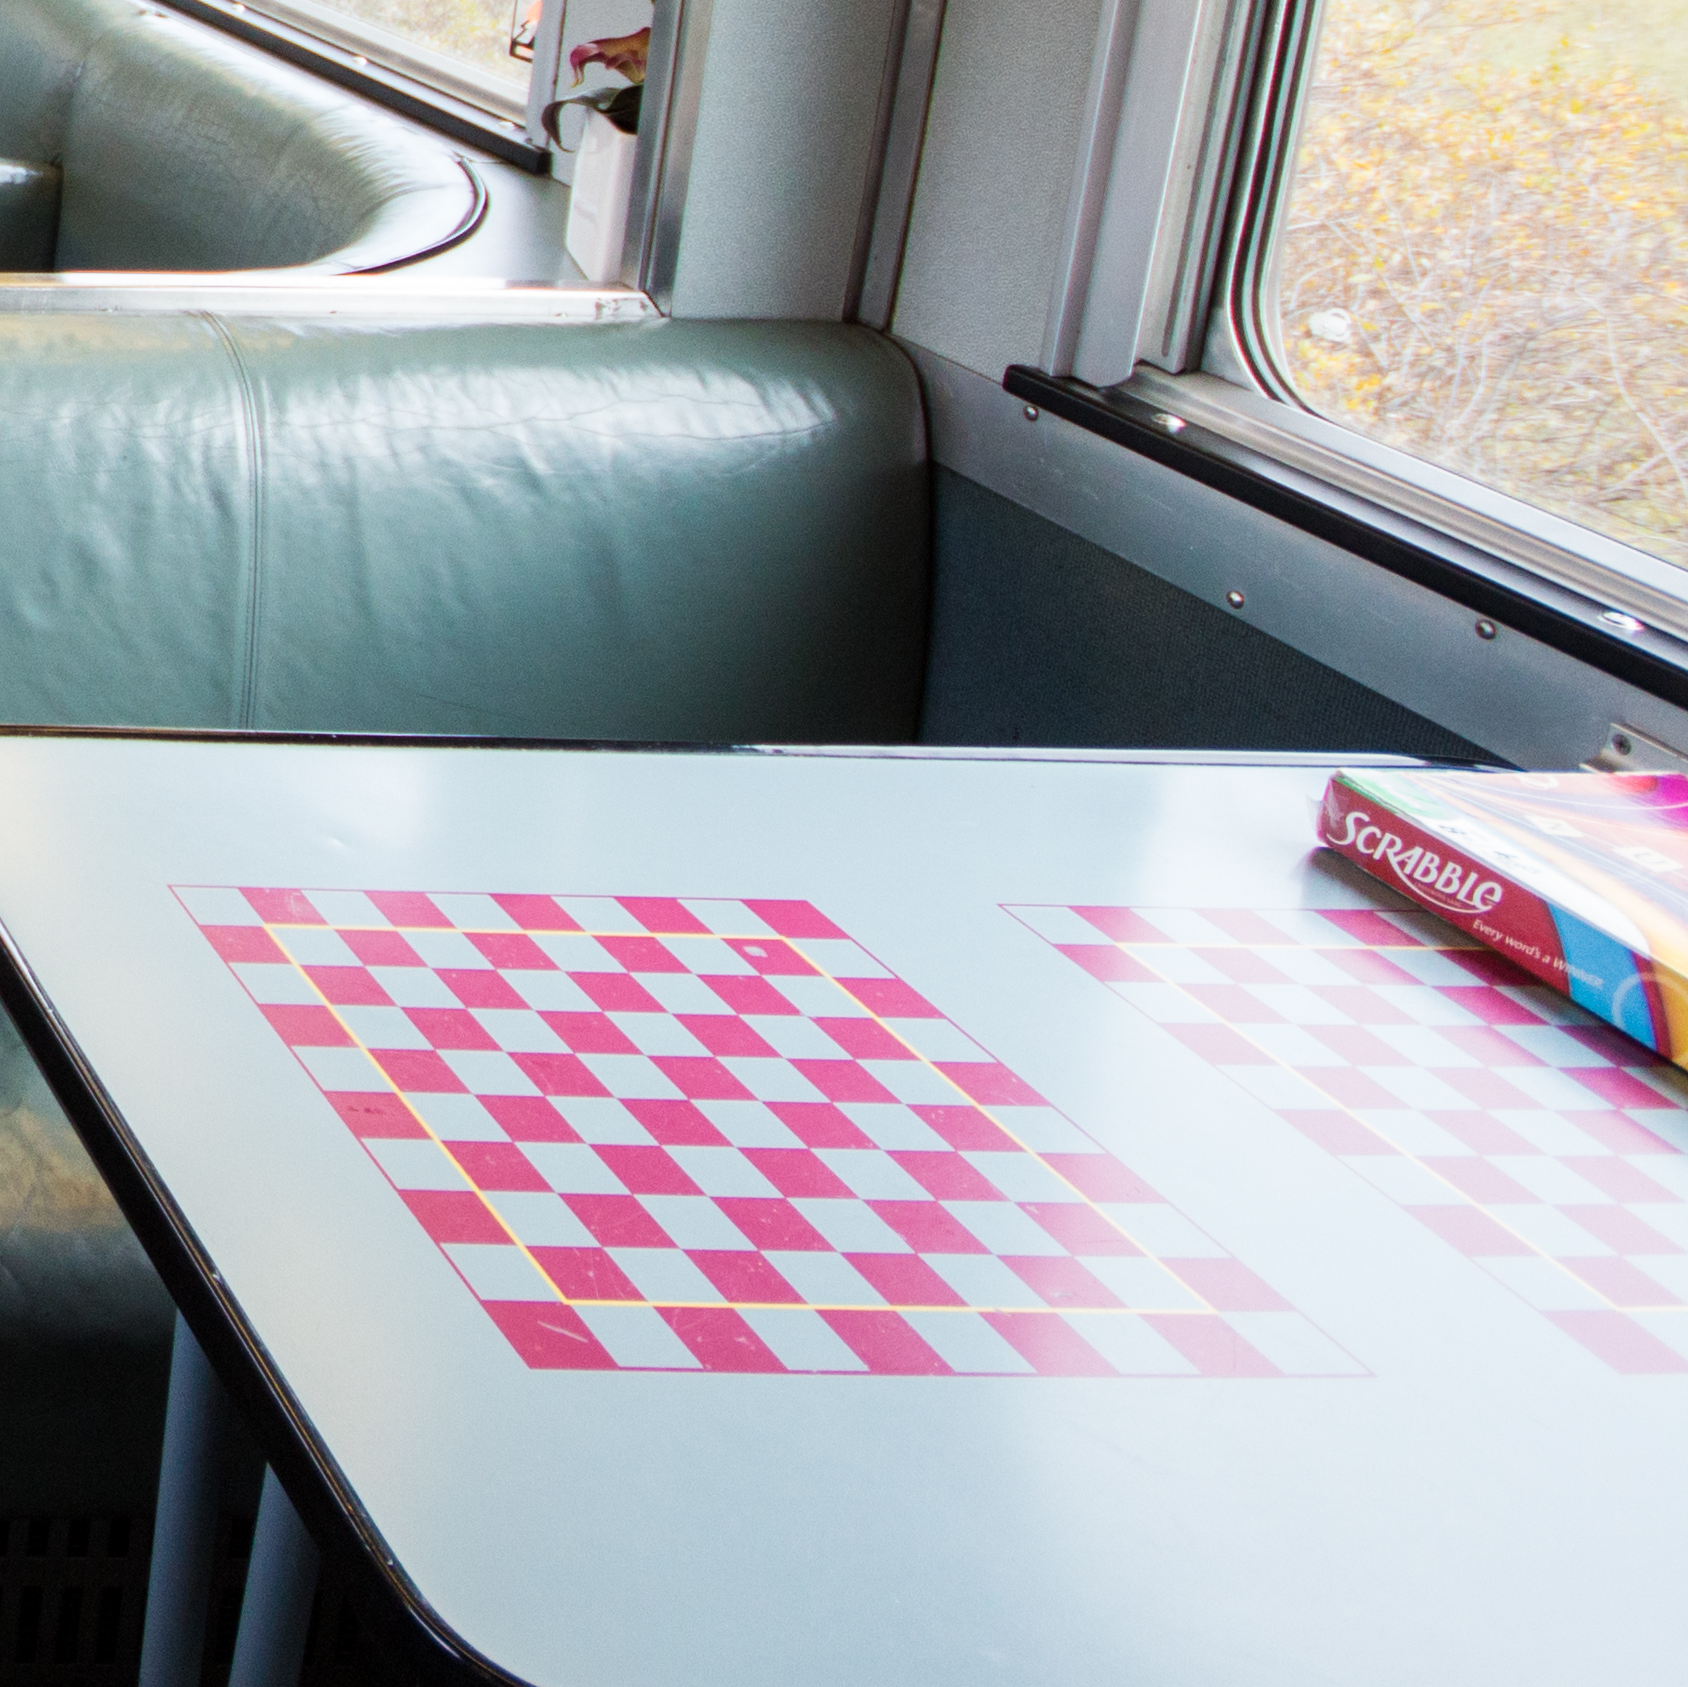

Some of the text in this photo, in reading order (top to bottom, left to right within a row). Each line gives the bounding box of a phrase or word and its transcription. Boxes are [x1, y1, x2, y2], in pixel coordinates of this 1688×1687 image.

[1326, 811, 1503, 914] SCRABBLE
[1473, 919, 1503, 942] Every
[1505, 936, 1541, 959] word's
[1542, 954, 1551, 964] a
